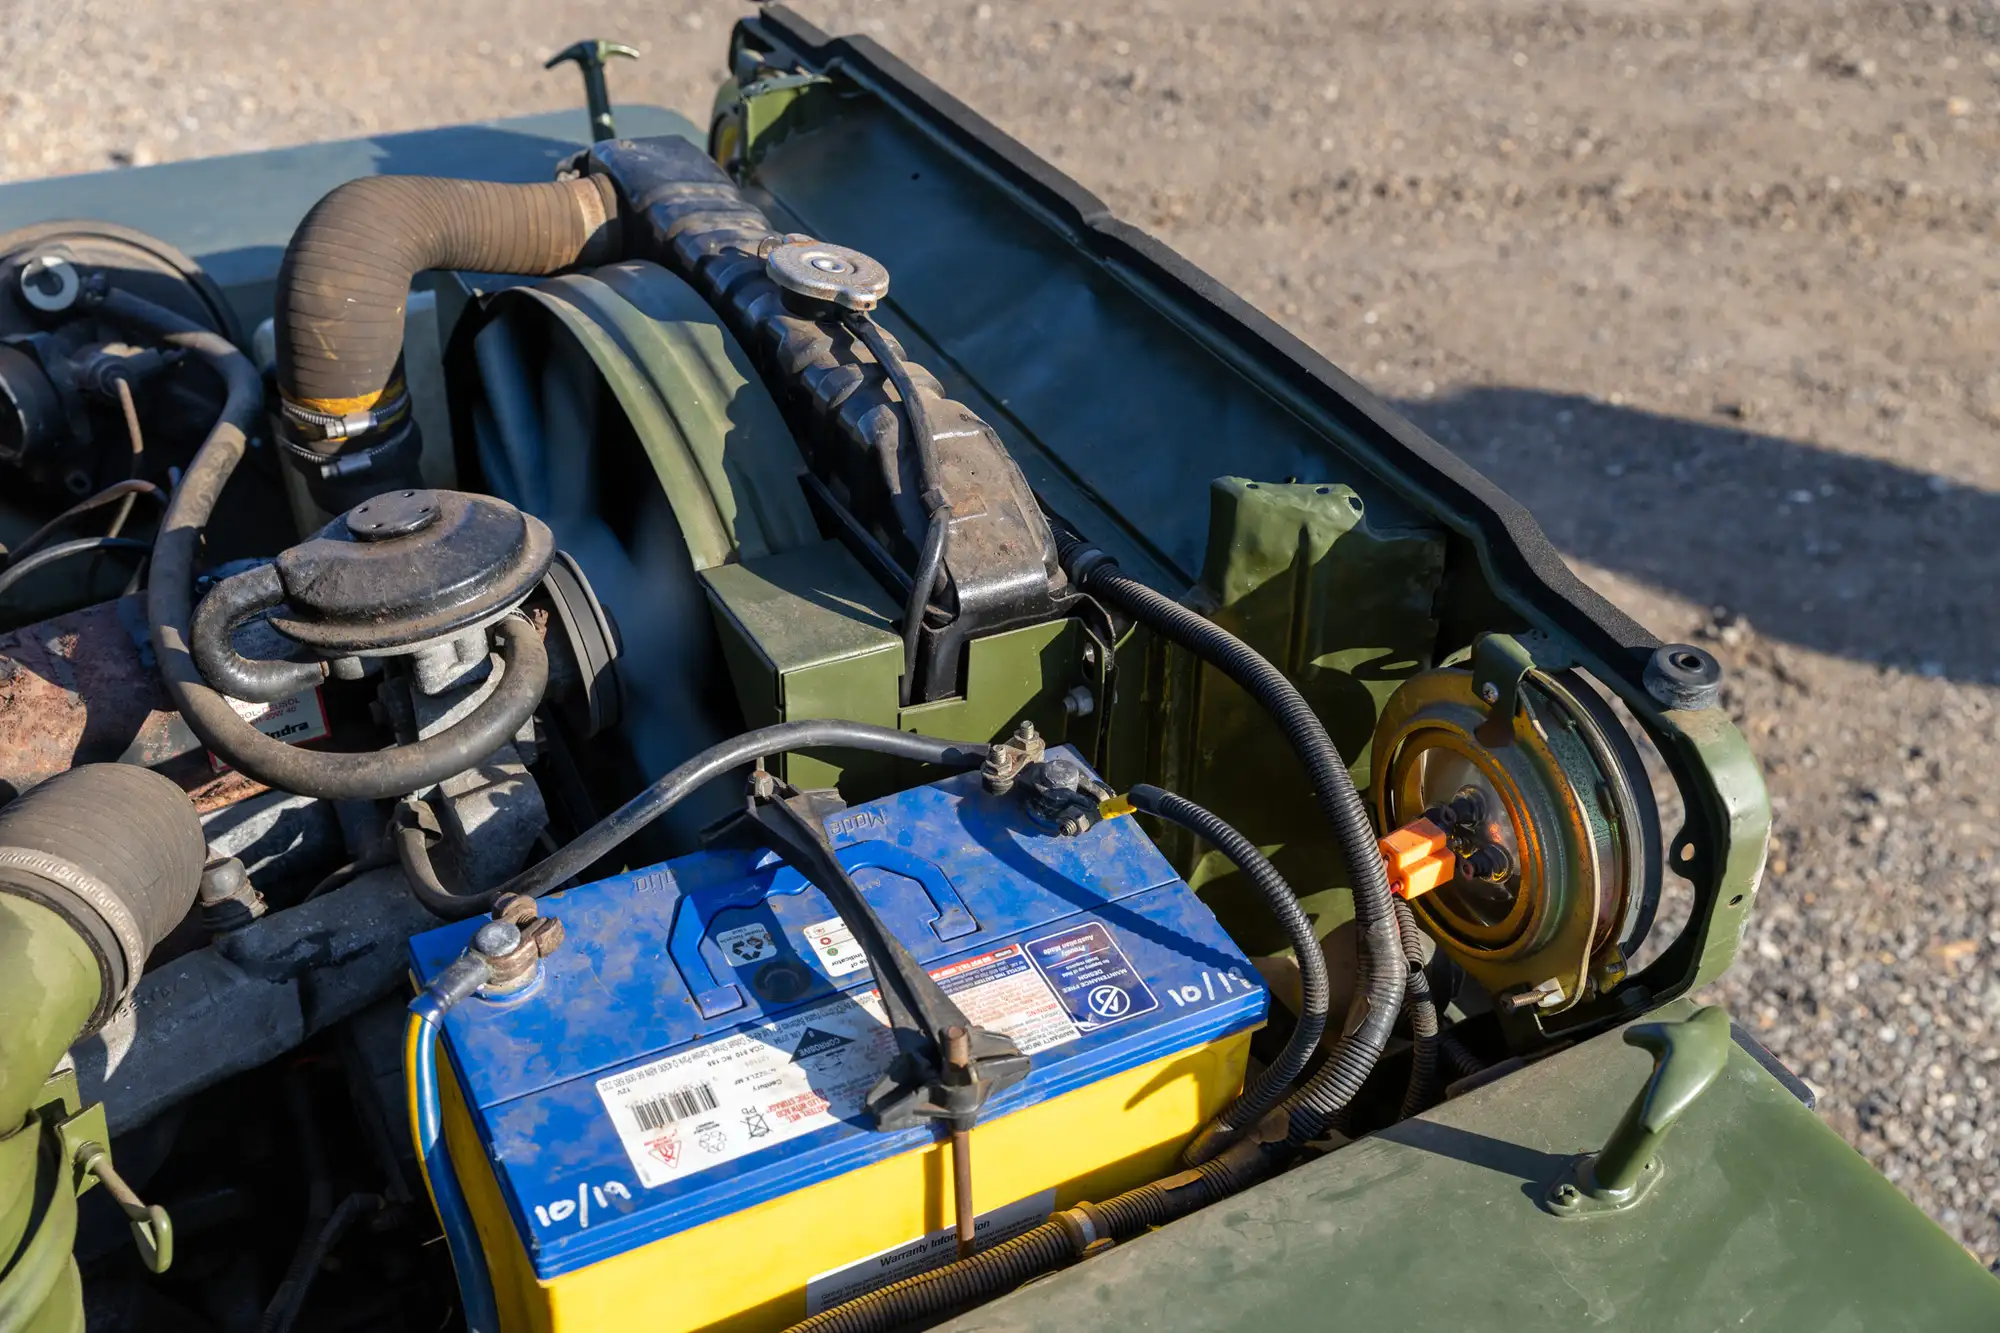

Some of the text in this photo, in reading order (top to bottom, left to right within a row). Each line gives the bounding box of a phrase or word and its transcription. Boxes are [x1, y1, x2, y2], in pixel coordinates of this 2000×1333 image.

[1043, 934, 1094, 955] Australian Made
[1061, 945, 1086, 957] Proudly
[831, 952, 864, 967] Indicator
[1061, 968, 1128, 993] MAINTENANCE FREE
[1078, 969, 1103, 981] DESIGN
[749, 1044, 764, 1053] CCA
[798, 1037, 840, 1056] CORROSIVE
[617, 1087, 631, 1095] 12V
[753, 1078, 783, 1091] Century
[741, 1105, 757, 1115] Pb
[534, 1181, 632, 1228] 10/19
[880, 1242, 929, 1268] Warranty
